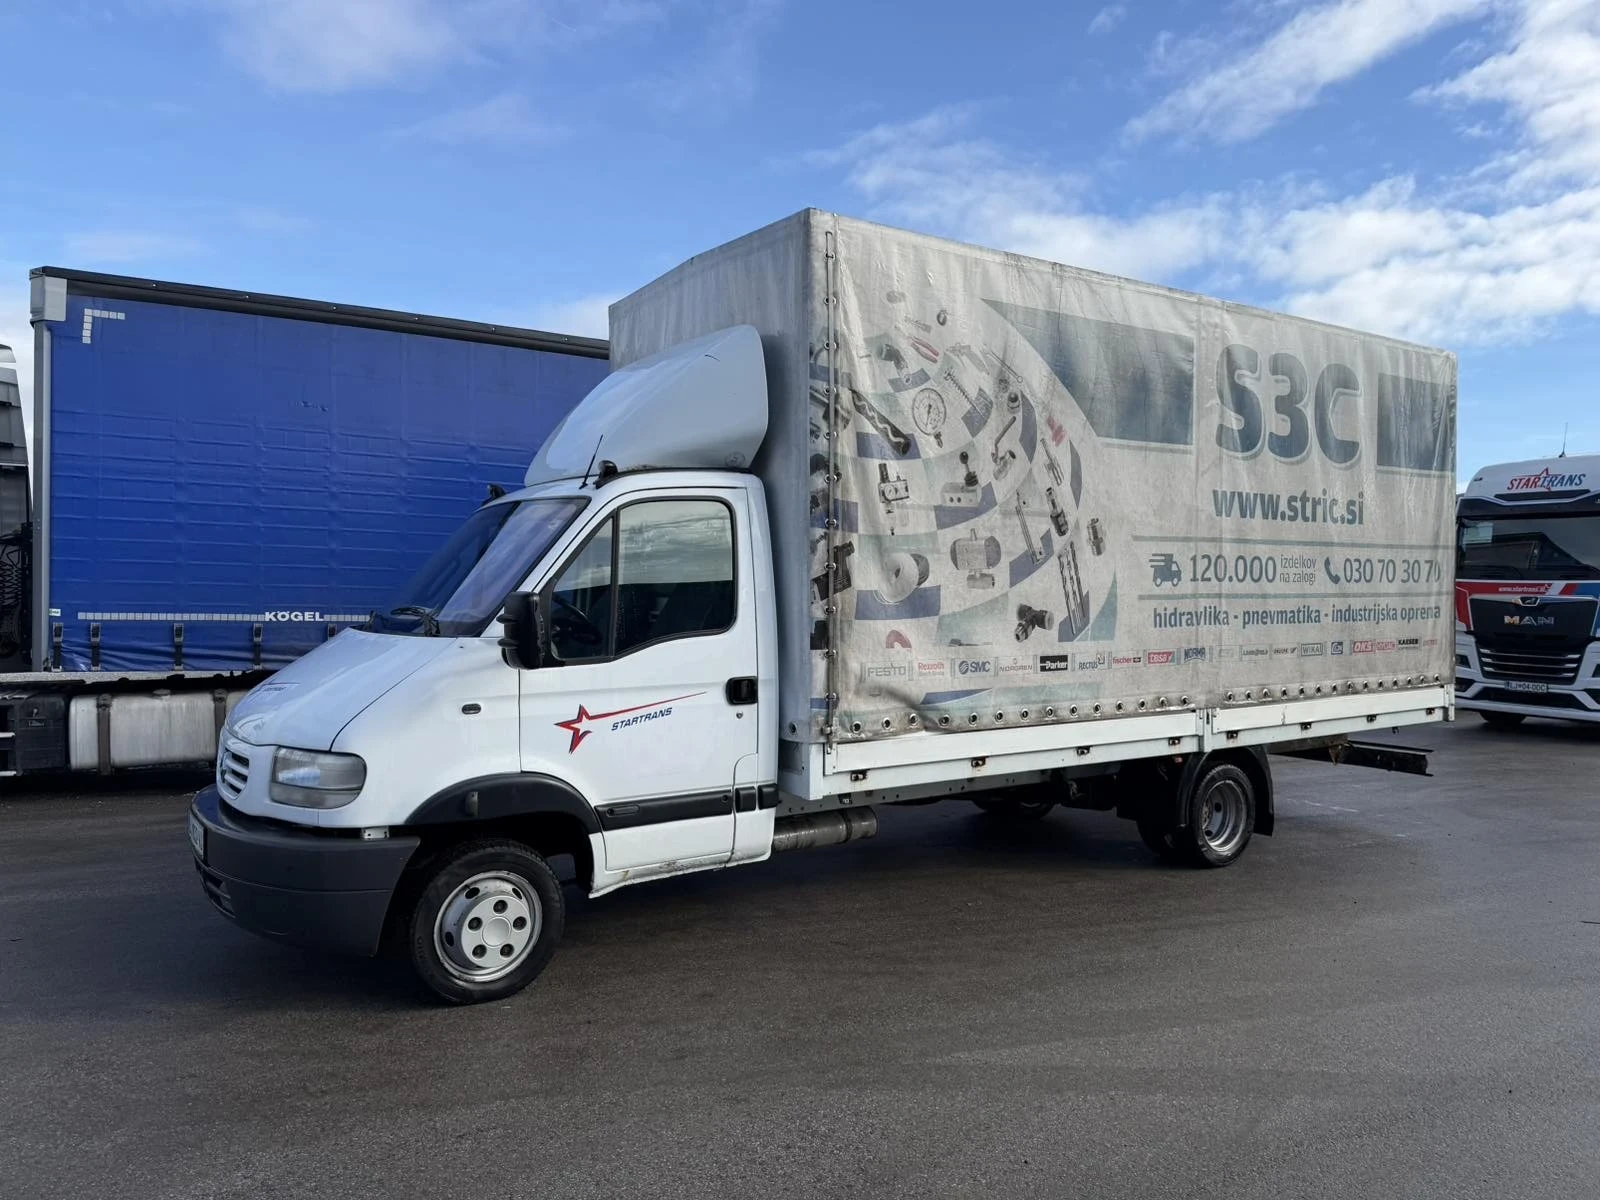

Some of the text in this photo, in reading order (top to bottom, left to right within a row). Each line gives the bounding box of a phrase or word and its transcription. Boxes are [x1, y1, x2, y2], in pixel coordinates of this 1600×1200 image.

[1215, 343, 1361, 466] S3C
[1507, 473, 1586, 491] STARTRANS
[1212, 488, 1364, 525] www.stric.si
[1190, 554, 1277, 583] 120.000
[1280, 556, 1317, 570] izdelkov
[1280, 570, 1317, 585] na zalogi
[1343, 558, 1441, 584] 030 70 30 70
[264, 611, 324, 622] KÖGEL
[1153, 605, 1230, 628] hidravlika
[1242, 605, 1321, 629] pnevmatika
[1331, 603, 1397, 625] industrijska
[1504, 615, 1555, 626] MAN
[1302, 645, 1321, 654] WIKA
[969, 661, 991, 673] SMC
[1045, 660, 1068, 670] Parker
[1113, 656, 1132, 665] fischer
[867, 662, 906, 678] FESTO
[611, 707, 673, 731] STARTRANS
